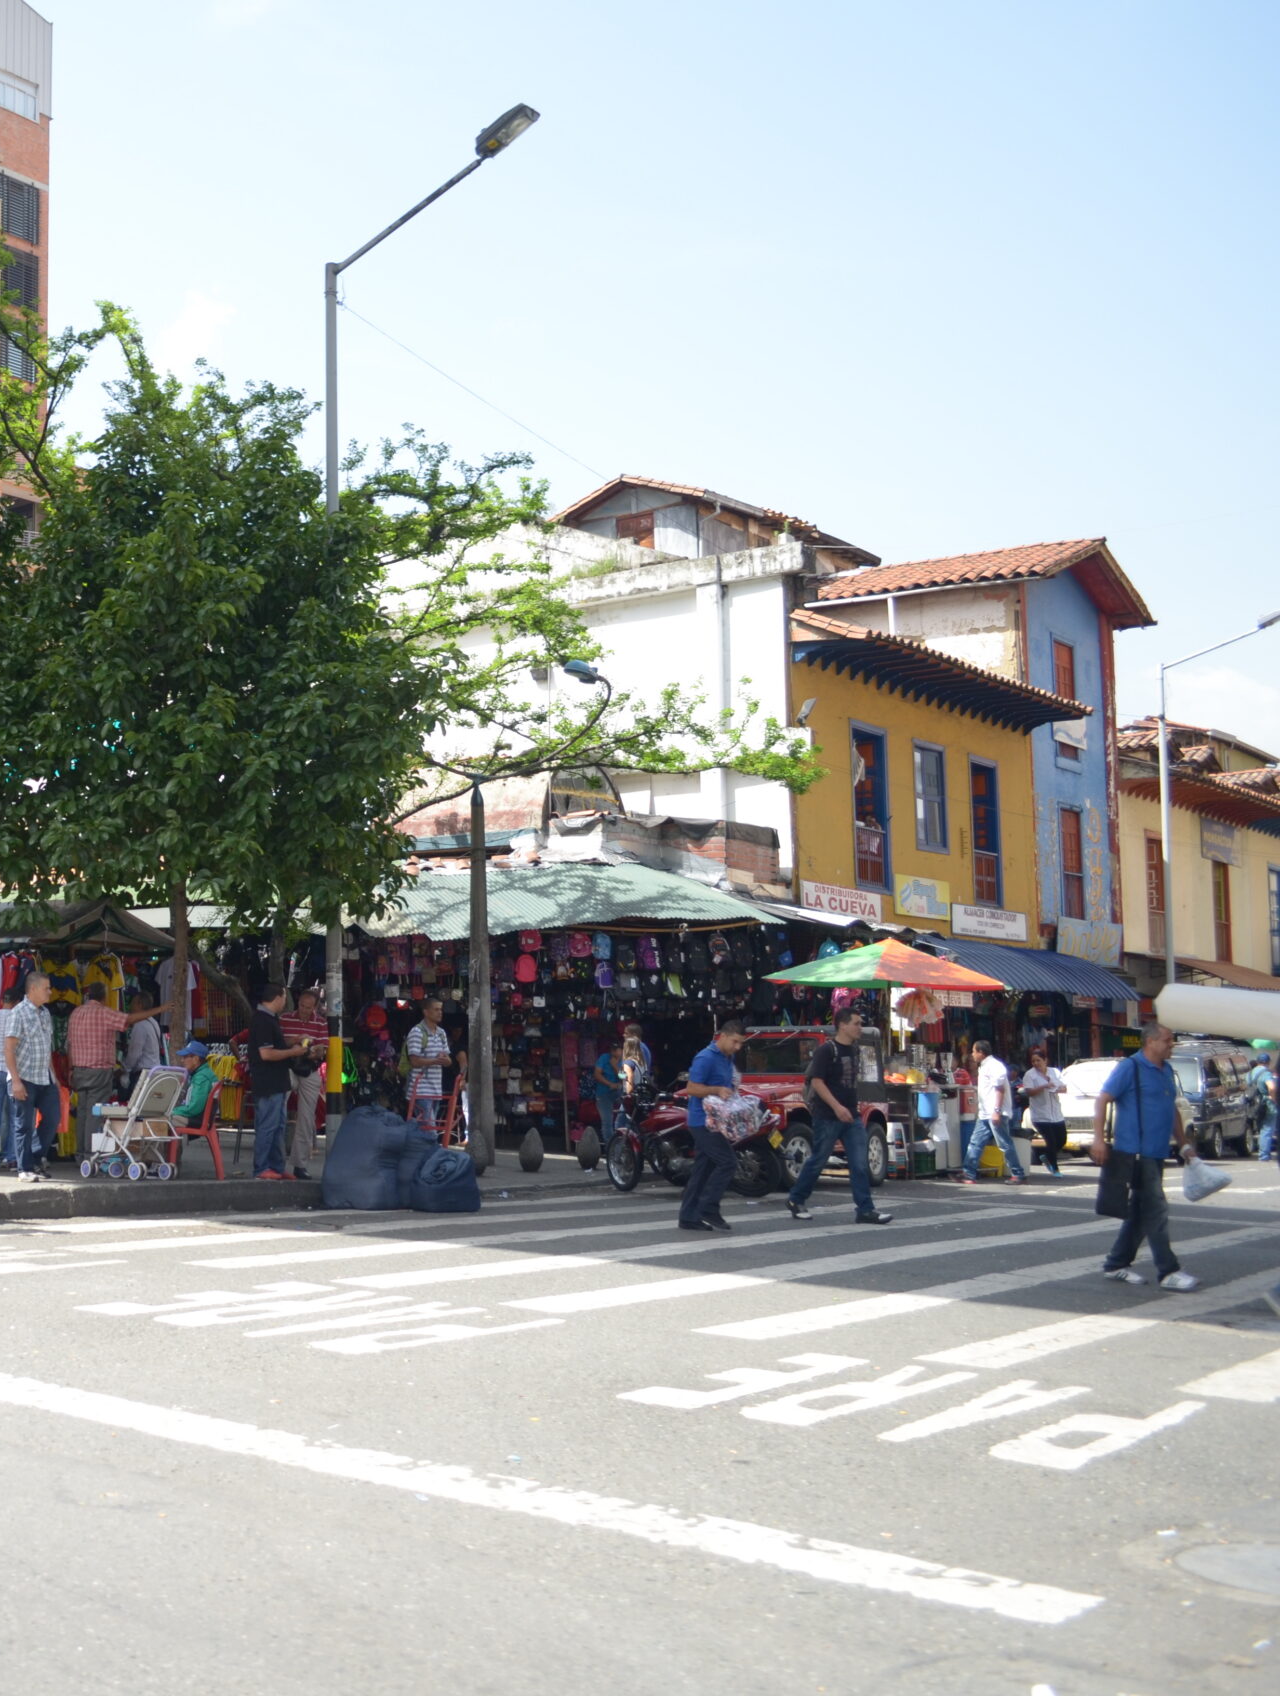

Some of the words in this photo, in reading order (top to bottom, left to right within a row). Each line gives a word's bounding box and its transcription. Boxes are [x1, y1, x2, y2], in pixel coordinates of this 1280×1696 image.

[814, 885, 868, 901] DISTRIBUIDORA
[805, 892, 823, 908] LA
[828, 896, 877, 917] CUEVA
